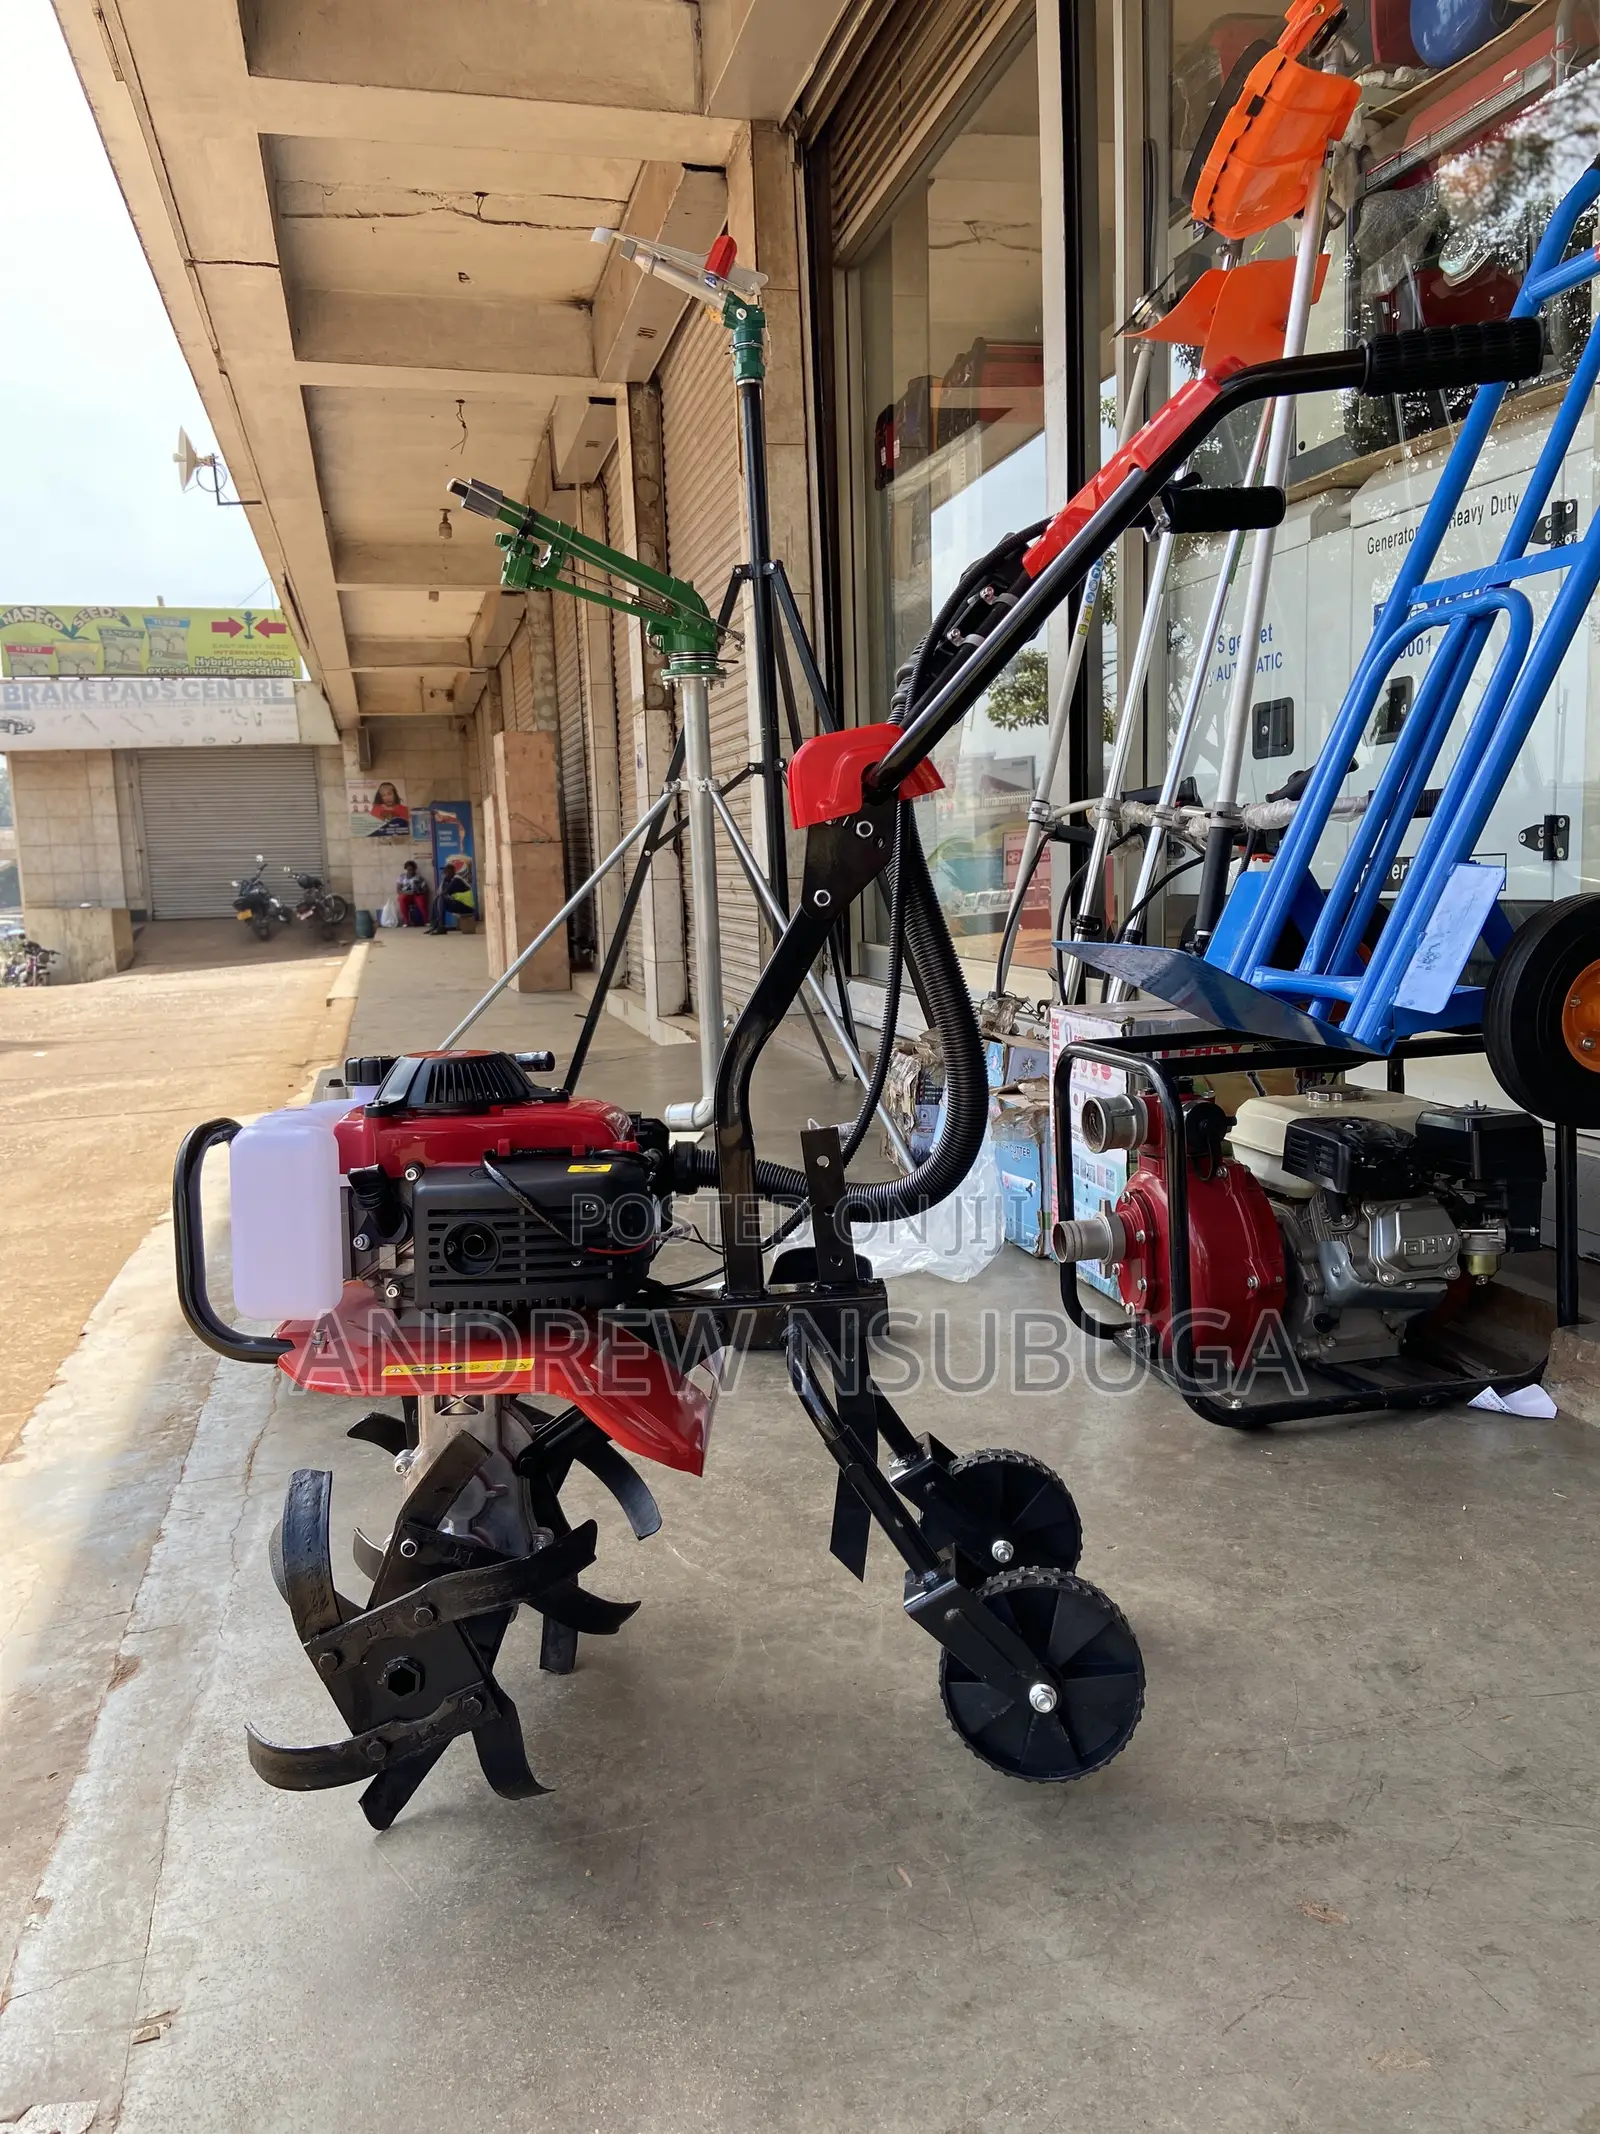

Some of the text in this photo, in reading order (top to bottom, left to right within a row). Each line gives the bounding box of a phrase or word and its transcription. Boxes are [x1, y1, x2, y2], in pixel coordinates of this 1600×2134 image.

[1367, 527, 1419, 555] Generator
[1491, 492, 1520, 516] Duty
[2, 606, 63, 630] NASECO
[147, 666, 294, 677] exceed your Expectations
[195, 657, 295, 668] Hybrid seeds that
[1216, 652, 1283, 682] AUTATIC
[3, 680, 285, 703] BRAKE PADS CENTRE
[1403, 1236, 1454, 1257] OHV
